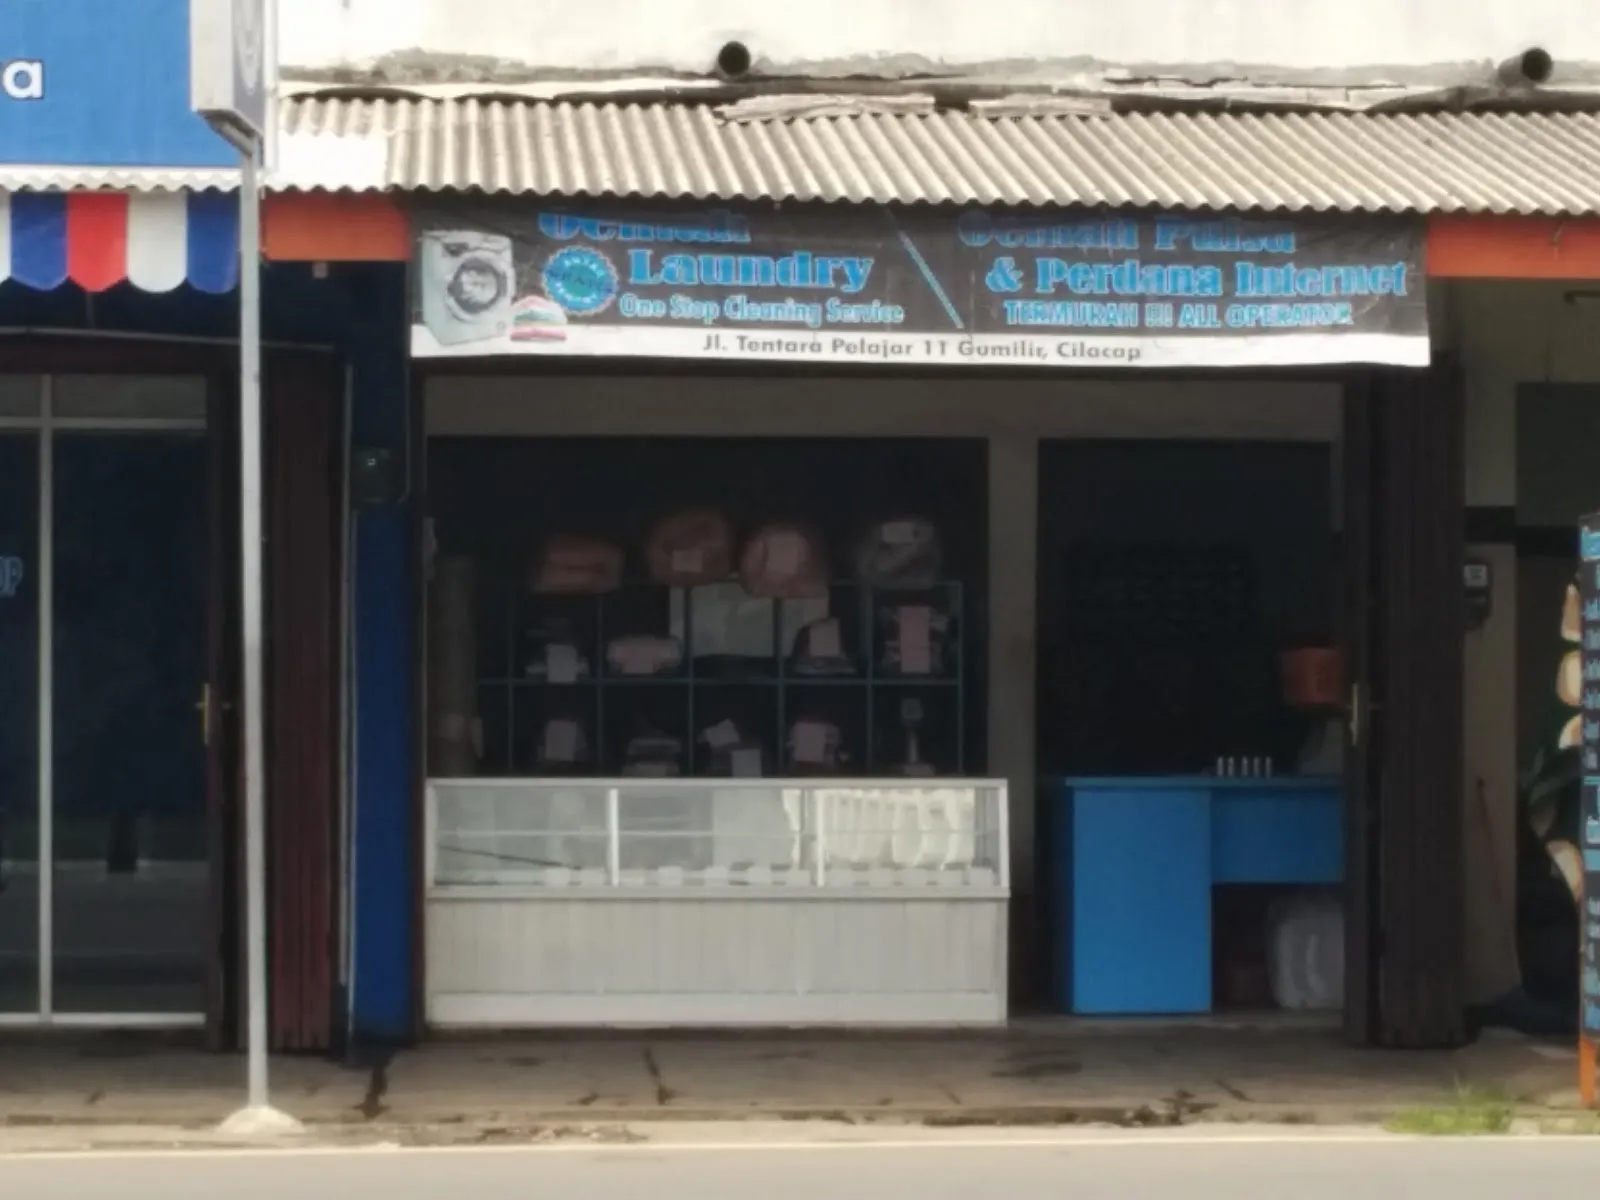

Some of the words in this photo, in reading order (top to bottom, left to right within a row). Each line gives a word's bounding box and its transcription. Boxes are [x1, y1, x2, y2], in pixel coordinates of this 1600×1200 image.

[628, 248, 874, 293] Laundry
[985, 256, 1024, 293] &
[1035, 256, 1224, 296] Perdana
[1235, 261, 1408, 297] Internet
[619, 293, 667, 318] One
[669, 293, 720, 325] Stop
[723, 295, 823, 328] Cleaning
[825, 297, 905, 324] Service
[1004, 300, 1138, 327] TERMURAH
[1178, 303, 1222, 328] ALL
[1225, 302, 1354, 328] OPERATOR
[703, 334, 727, 352] Jl.
[737, 335, 822, 354] Tentara
[831, 338, 913, 358] Pelajar
[924, 340, 946, 356] 11
[958, 340, 1048, 360] Gumilir,
[1056, 341, 1142, 362] Cilacap
